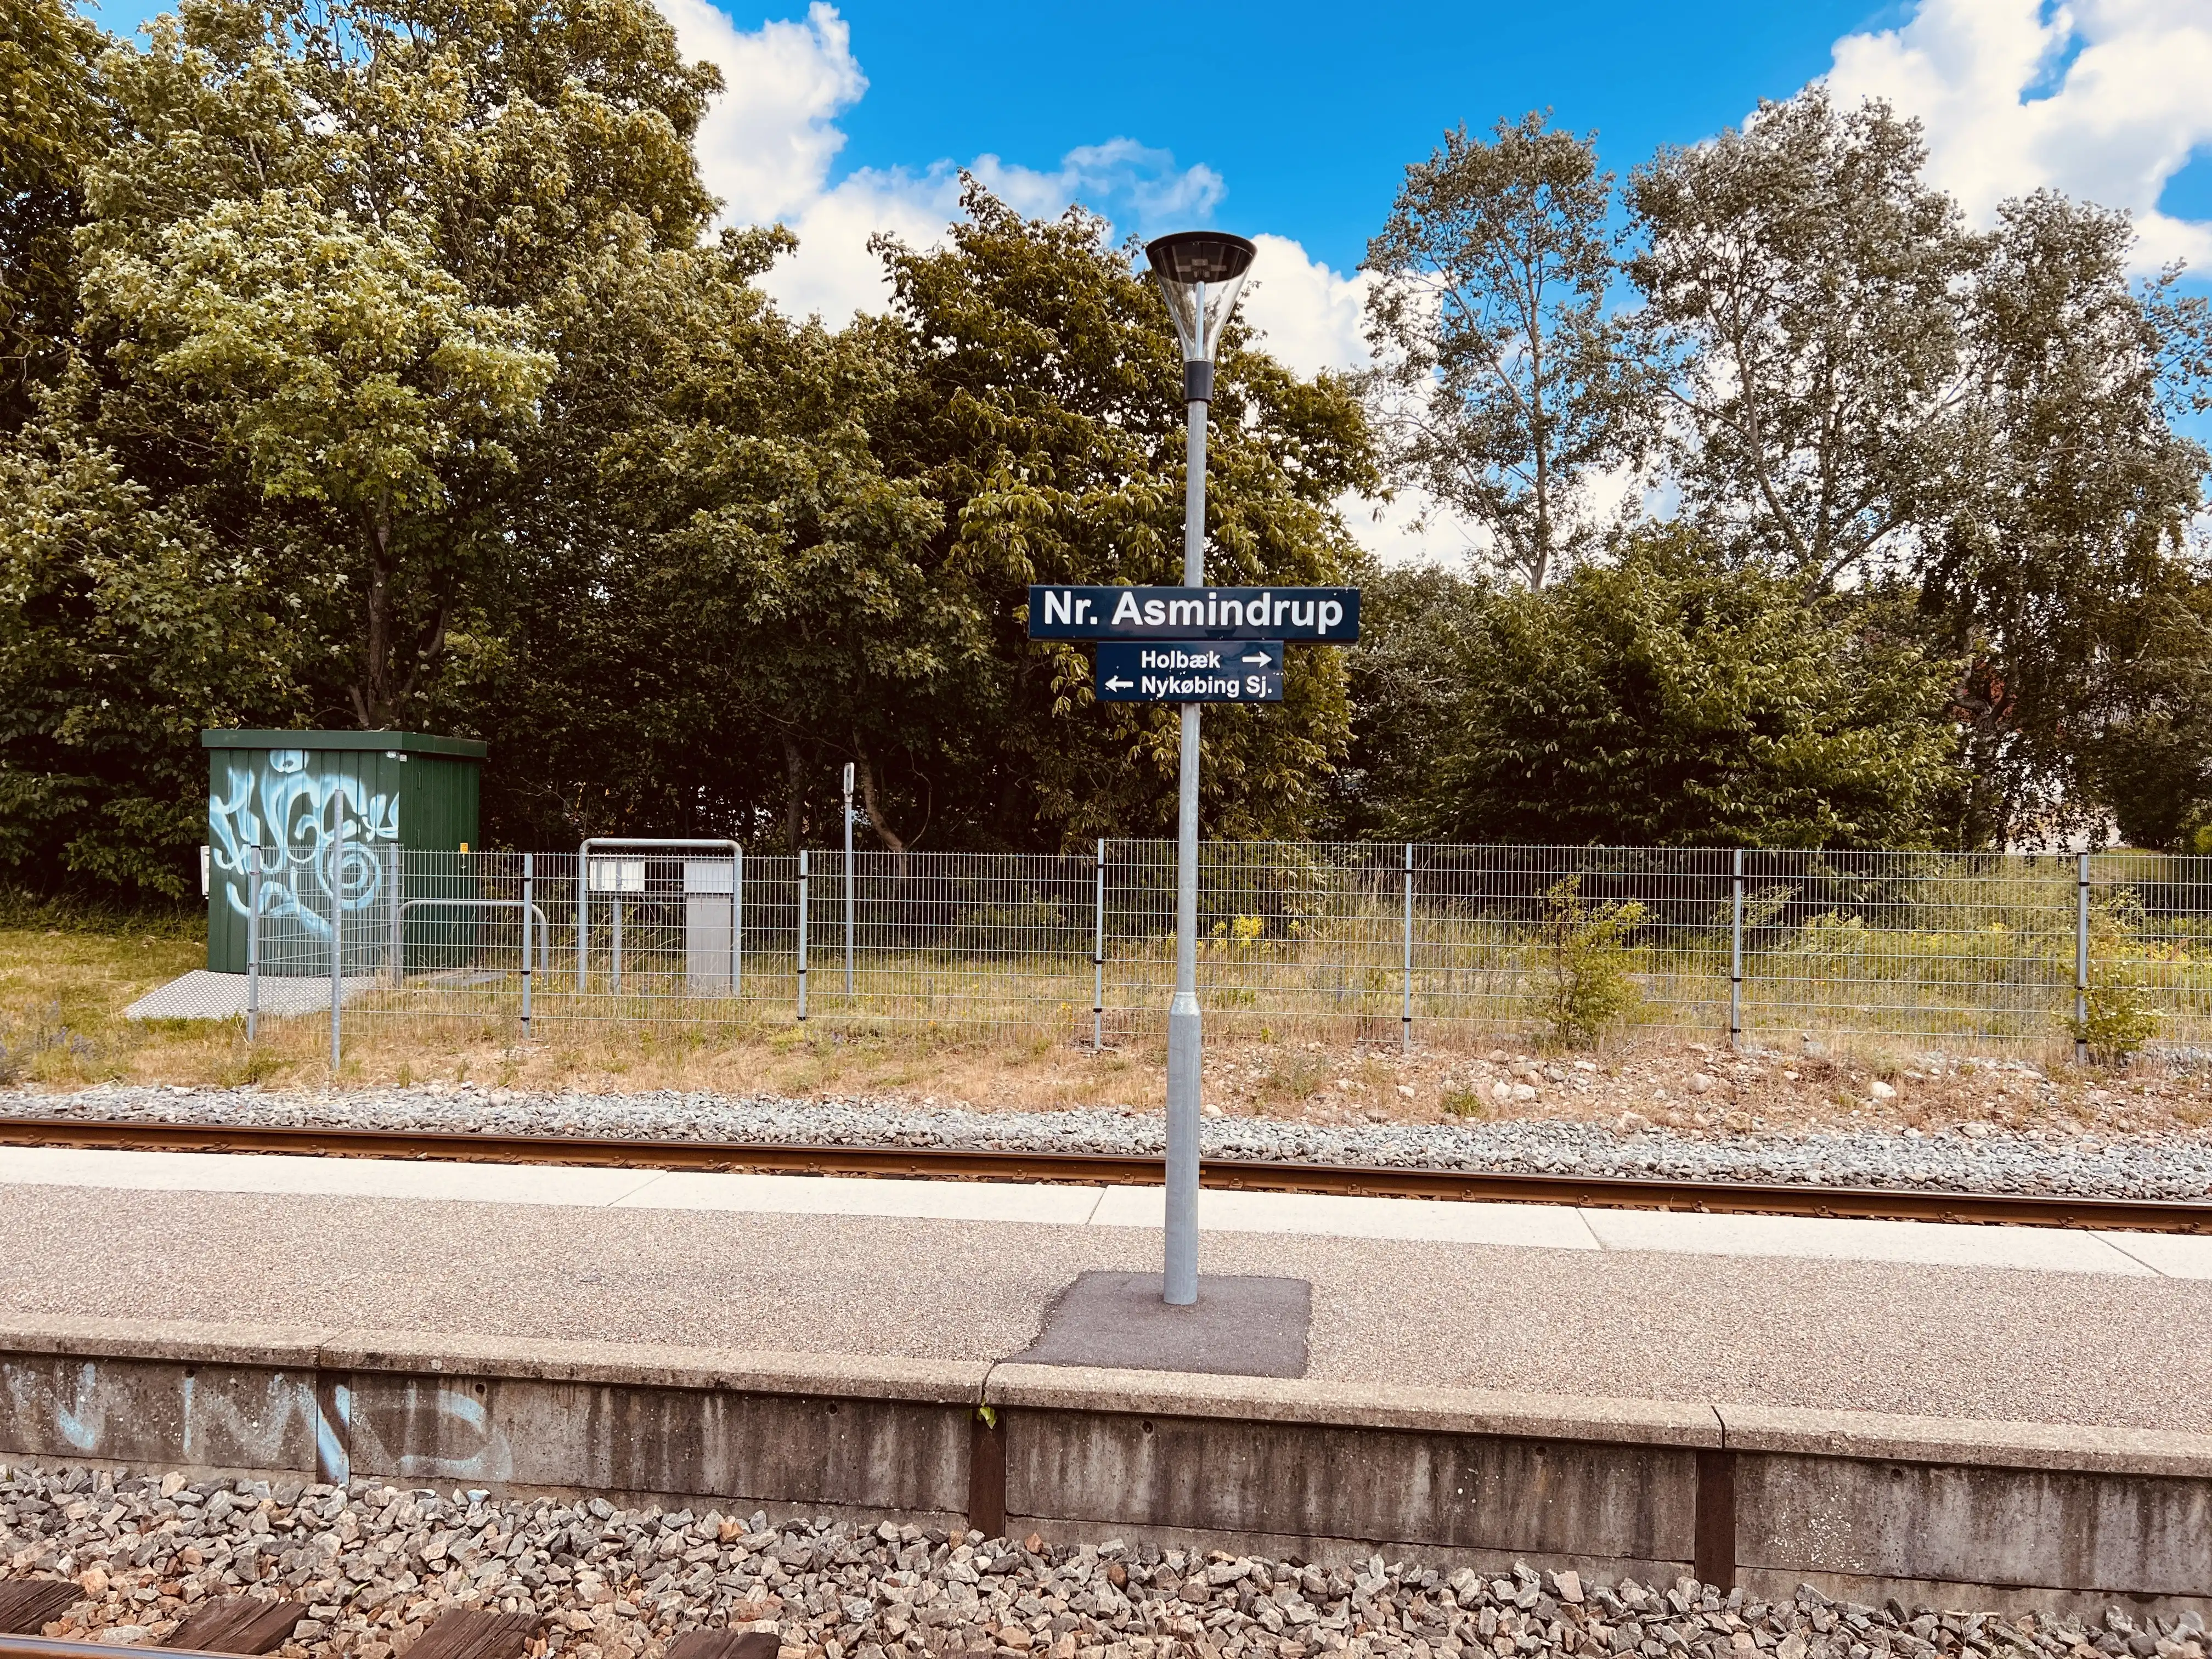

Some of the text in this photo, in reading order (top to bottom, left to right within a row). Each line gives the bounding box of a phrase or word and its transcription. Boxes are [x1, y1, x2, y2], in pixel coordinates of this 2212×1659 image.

[1045, 591, 1344, 635] Nr. Asmindrup
[1142, 651, 1221, 669] Holbæk
[1142, 676, 1272, 698] Nykøbing Sj.
